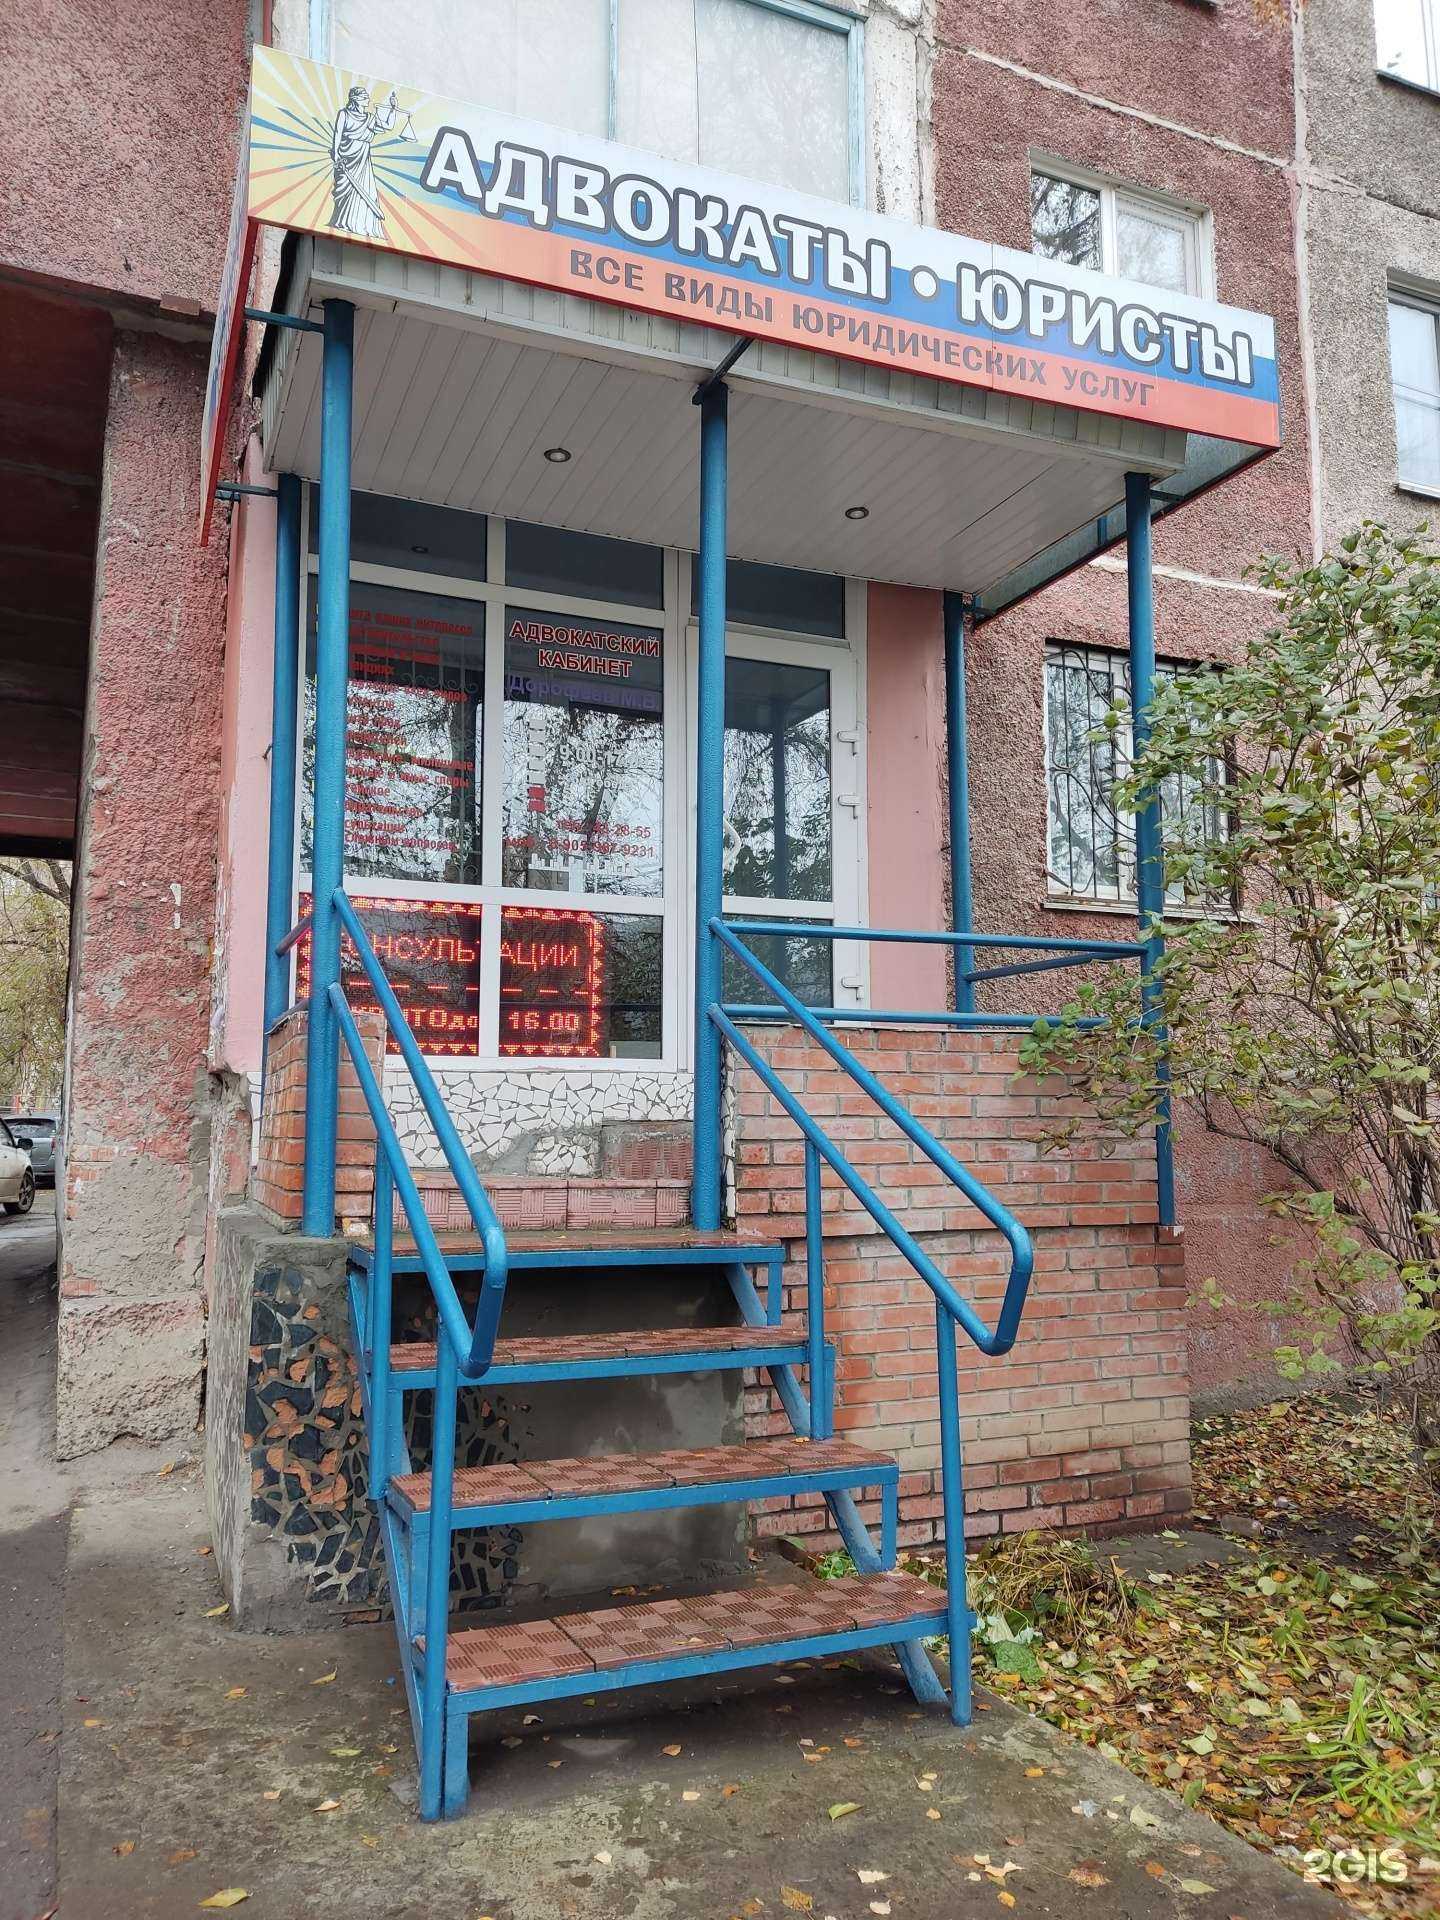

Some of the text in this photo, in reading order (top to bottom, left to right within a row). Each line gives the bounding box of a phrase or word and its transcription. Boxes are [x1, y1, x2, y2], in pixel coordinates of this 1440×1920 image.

[421, 126, 1254, 387] АДВОКАТЫ ЮРИСТЫ
[570, 249, 1155, 407] ВСЕ ВИДЫ ЮРИДИЧЕСКИХ УСЛУГ
[509, 619, 660, 658] АДВОКАТСКИЙ
[538, 648, 633, 678] КАБИНЕТ
[508, 1011, 580, 1031] 16.00
